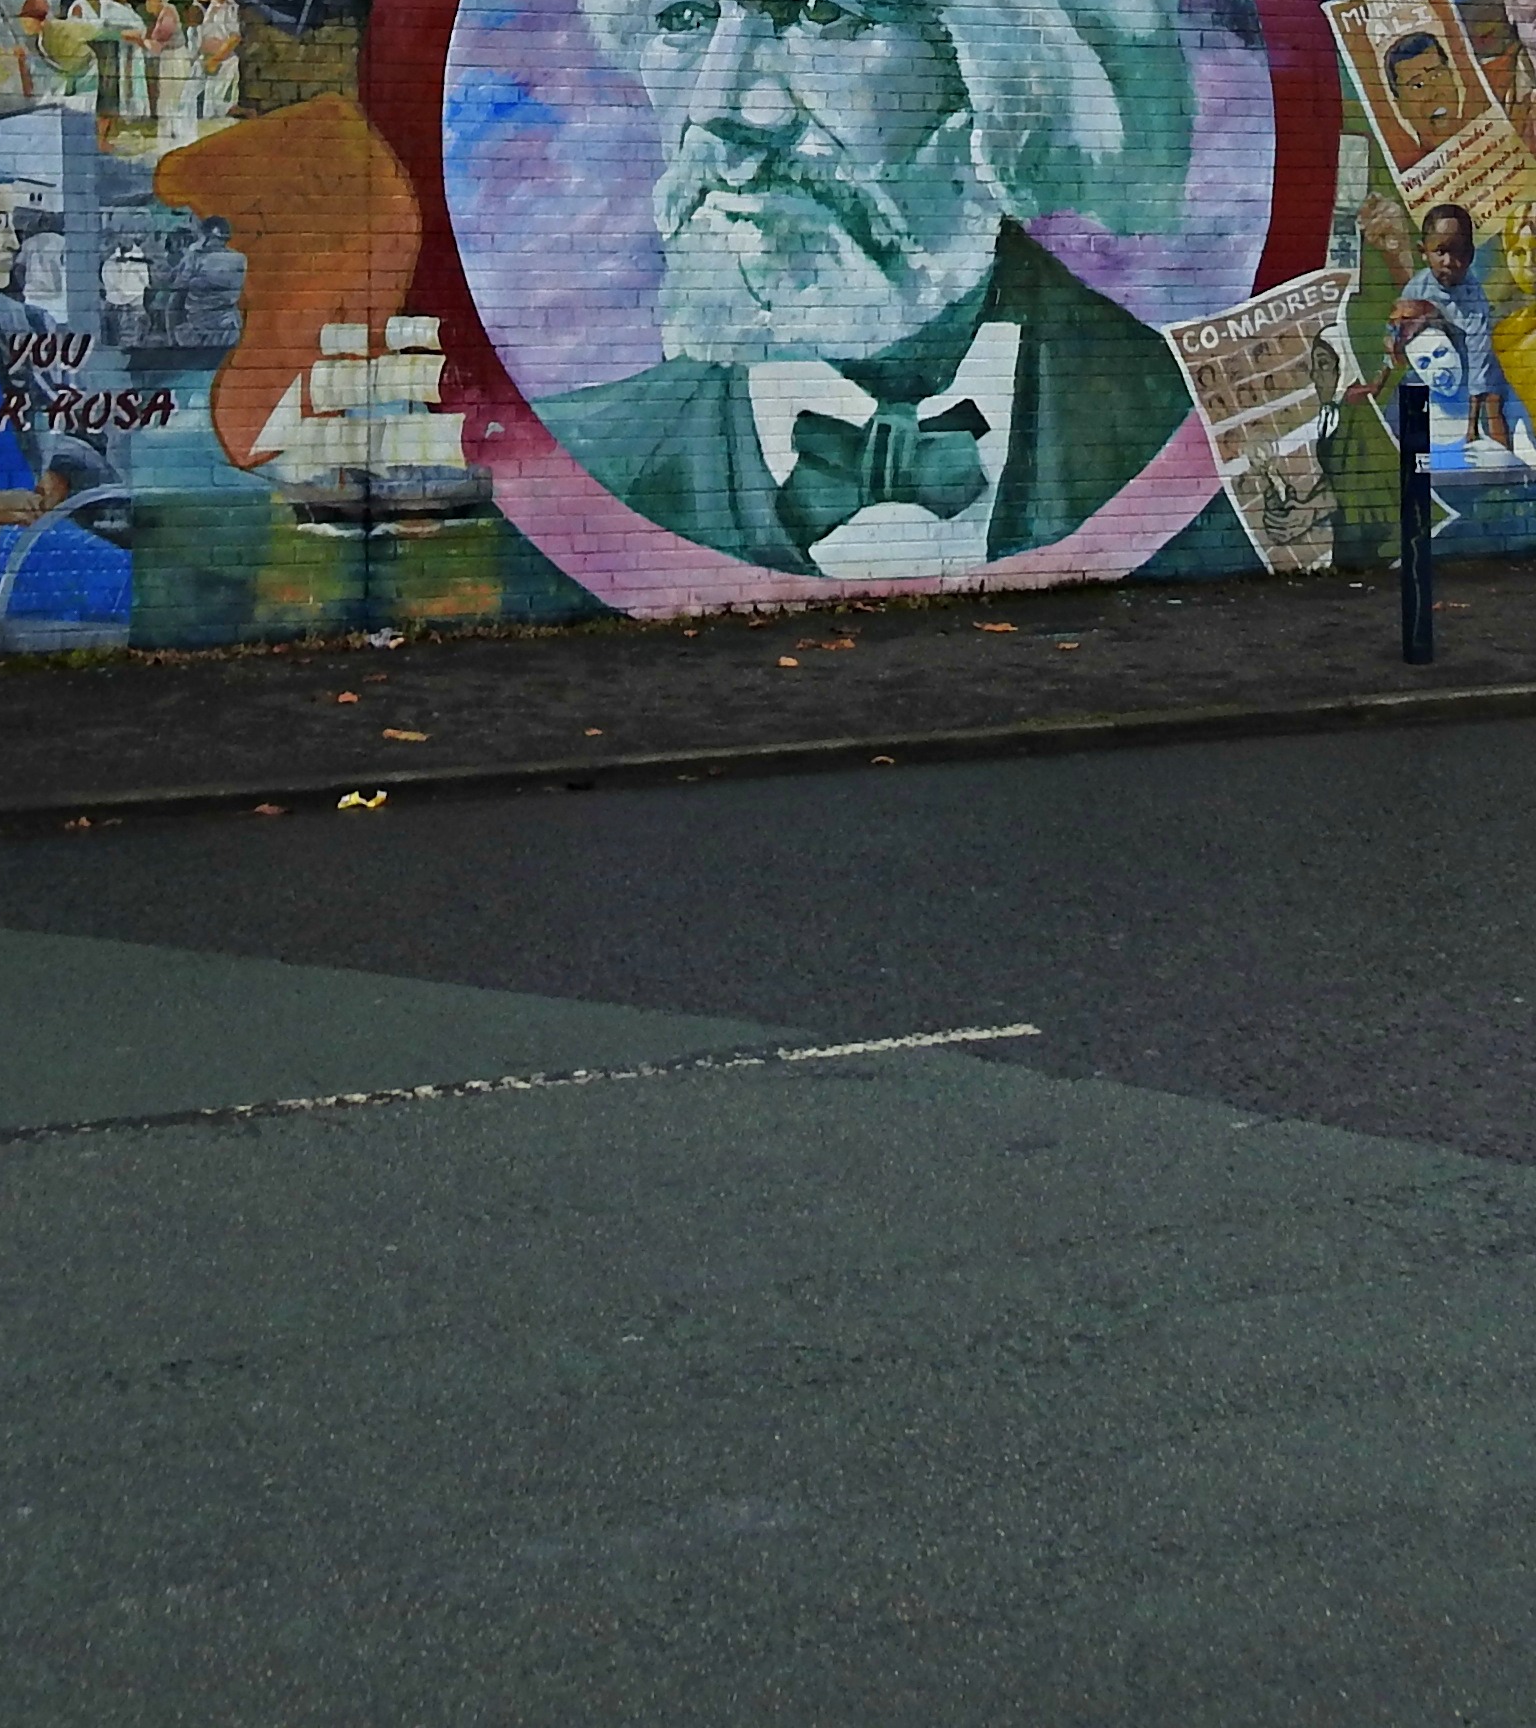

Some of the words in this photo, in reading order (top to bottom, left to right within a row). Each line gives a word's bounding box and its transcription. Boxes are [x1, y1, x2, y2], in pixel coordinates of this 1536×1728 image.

[1375, 5, 1433, 44] ALI
[1183, 280, 1341, 354] CO-MADRES
[6, 333, 96, 374] YOU
[46, 383, 180, 435] ROSA
